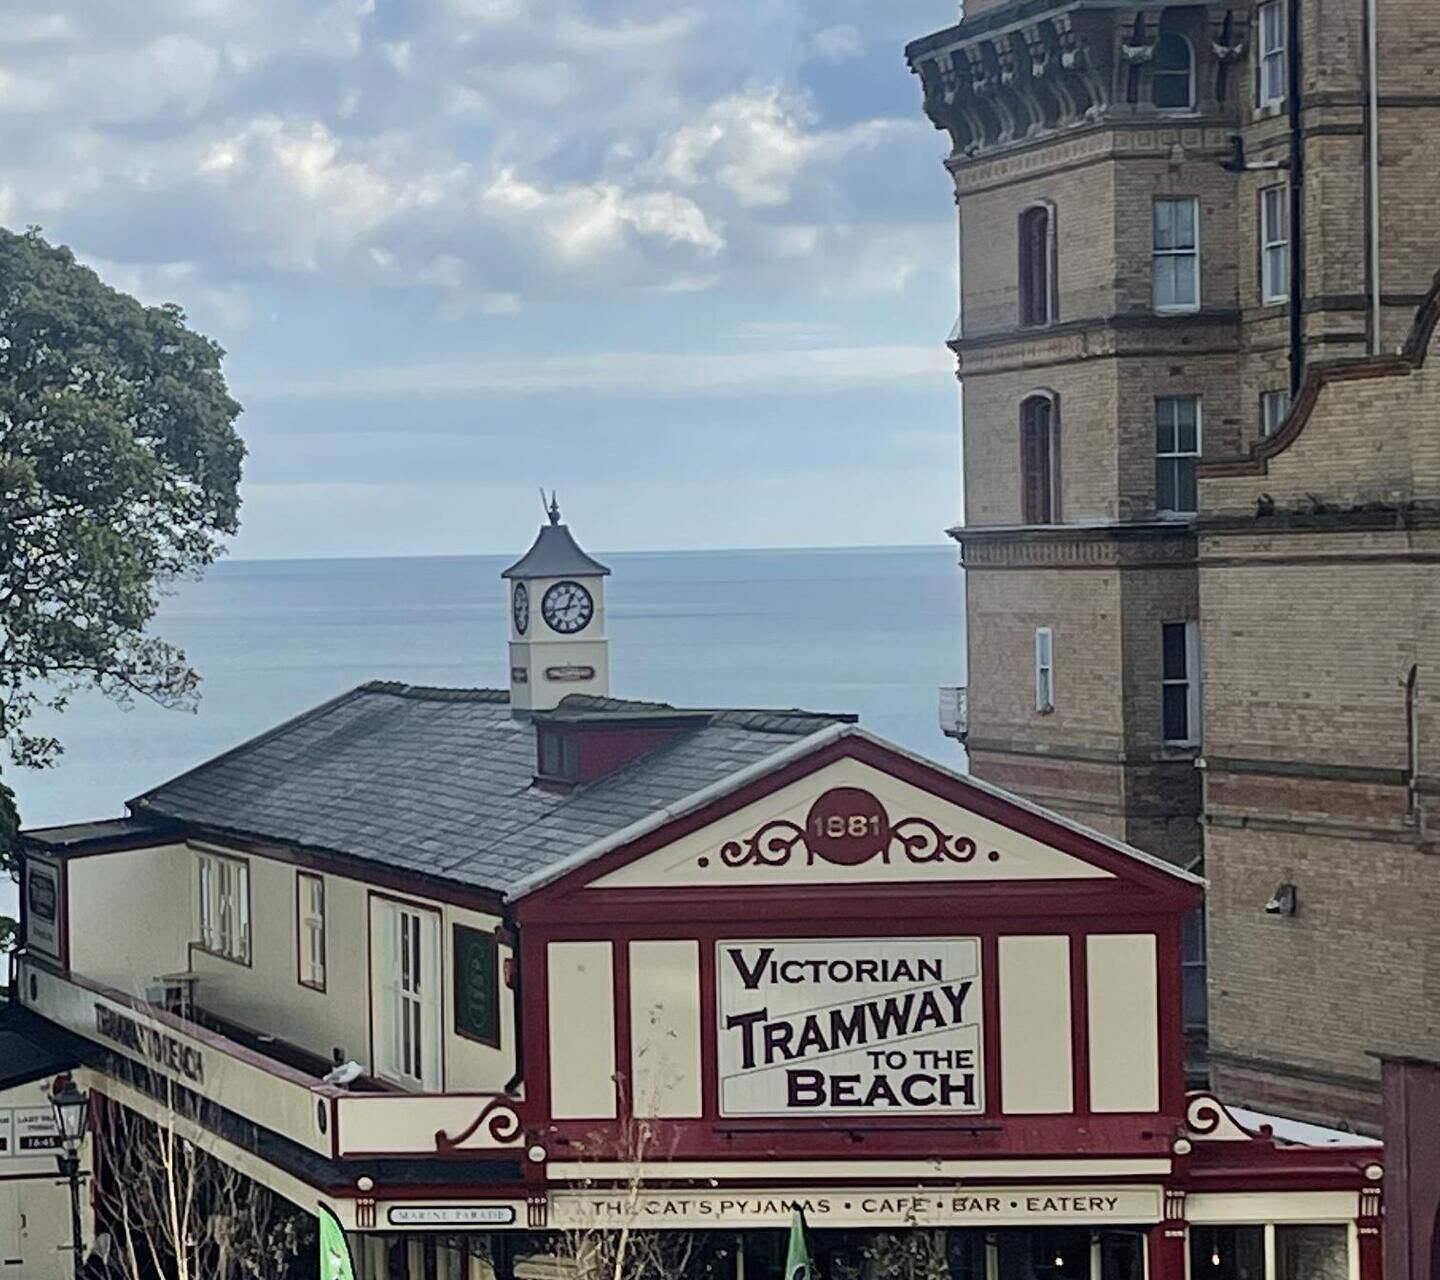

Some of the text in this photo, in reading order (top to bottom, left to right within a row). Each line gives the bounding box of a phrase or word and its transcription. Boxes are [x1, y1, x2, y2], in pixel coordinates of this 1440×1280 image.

[814, 815, 880, 838] 1881
[726, 948, 943, 990] VICTORIAN
[726, 981, 973, 1069] TRAMWAY
[866, 1050, 974, 1070] TO THE
[785, 1069, 976, 1107] BEACH
[720, 1199, 831, 1214] PYJAMAS
[952, 1197, 1001, 1212] BAR
[1026, 1196, 1119, 1212] EATERY
